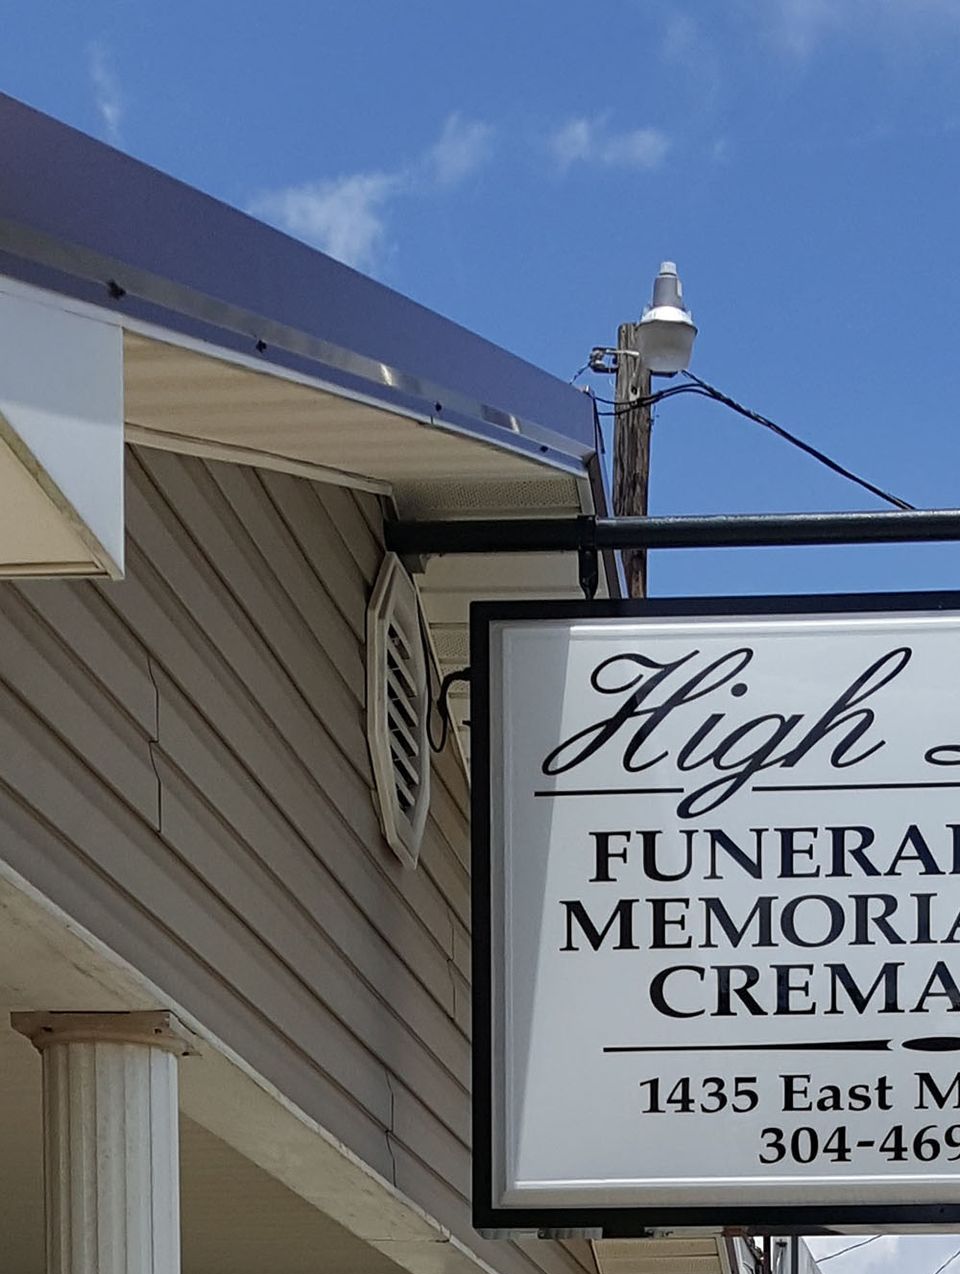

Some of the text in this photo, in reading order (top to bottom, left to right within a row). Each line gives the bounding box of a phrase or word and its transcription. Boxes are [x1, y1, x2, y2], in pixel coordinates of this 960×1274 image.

[541, 647, 913, 820] High
[640, 1076, 759, 1114] 1435
[779, 1072, 894, 1112] East
